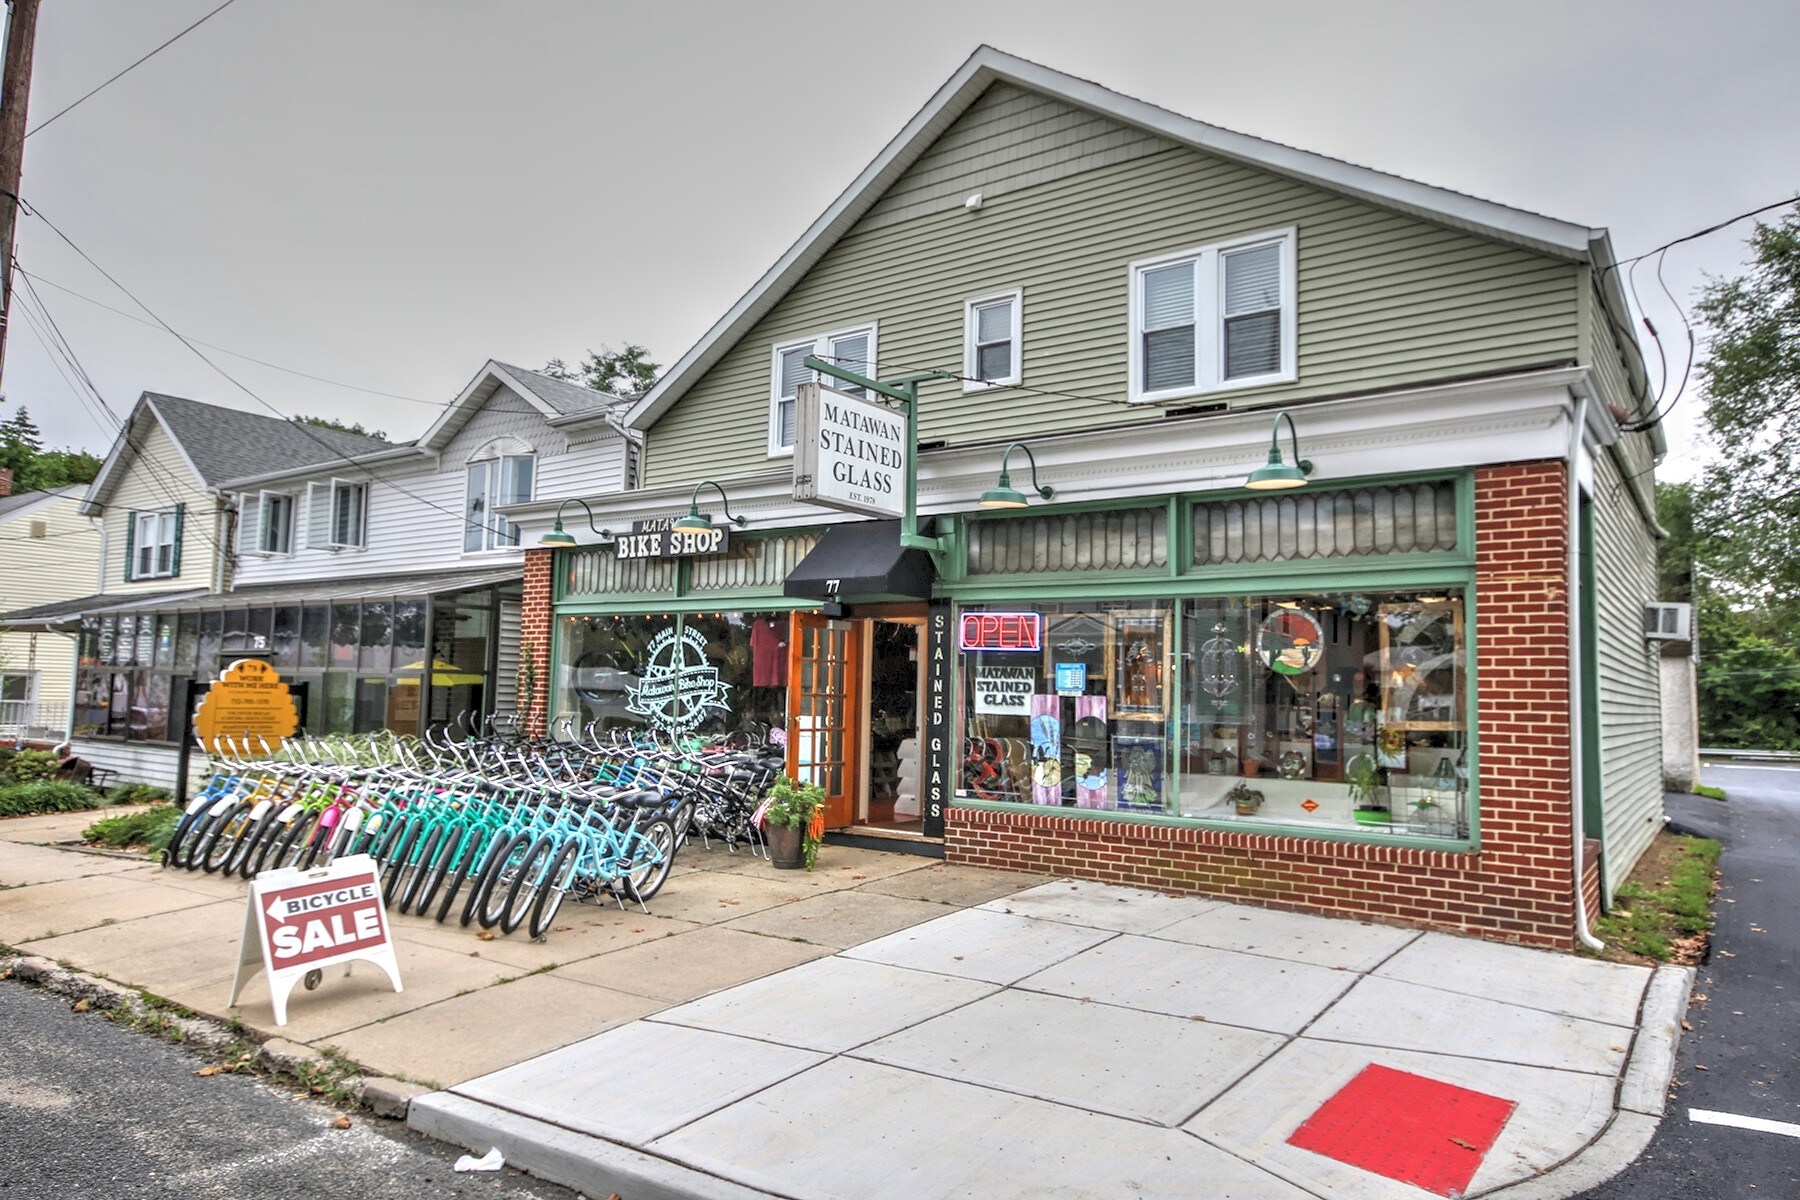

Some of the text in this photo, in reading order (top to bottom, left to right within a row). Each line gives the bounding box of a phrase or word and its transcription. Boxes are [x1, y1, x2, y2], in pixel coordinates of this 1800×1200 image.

[824, 403, 901, 443] MATAWAN
[820, 428, 902, 470] STAINED
[833, 461, 892, 494] GLASS
[849, 492, 876, 505] EST. 1978
[617, 528, 724, 559] BIKE SHOP
[825, 579, 840, 593] 77
[253, 635, 266, 649] 75
[654, 626, 674, 642] MAIN
[684, 625, 709, 647] STREET
[963, 614, 1039, 648] OPEN
[976, 667, 1034, 680] MATAWAN
[976, 680, 1032, 694] STAINED
[983, 693, 1026, 707] GLASS
[930, 615, 944, 817] STAINED GLASS
[286, 885, 373, 914] BICYCLE
[272, 907, 381, 959] SALE
